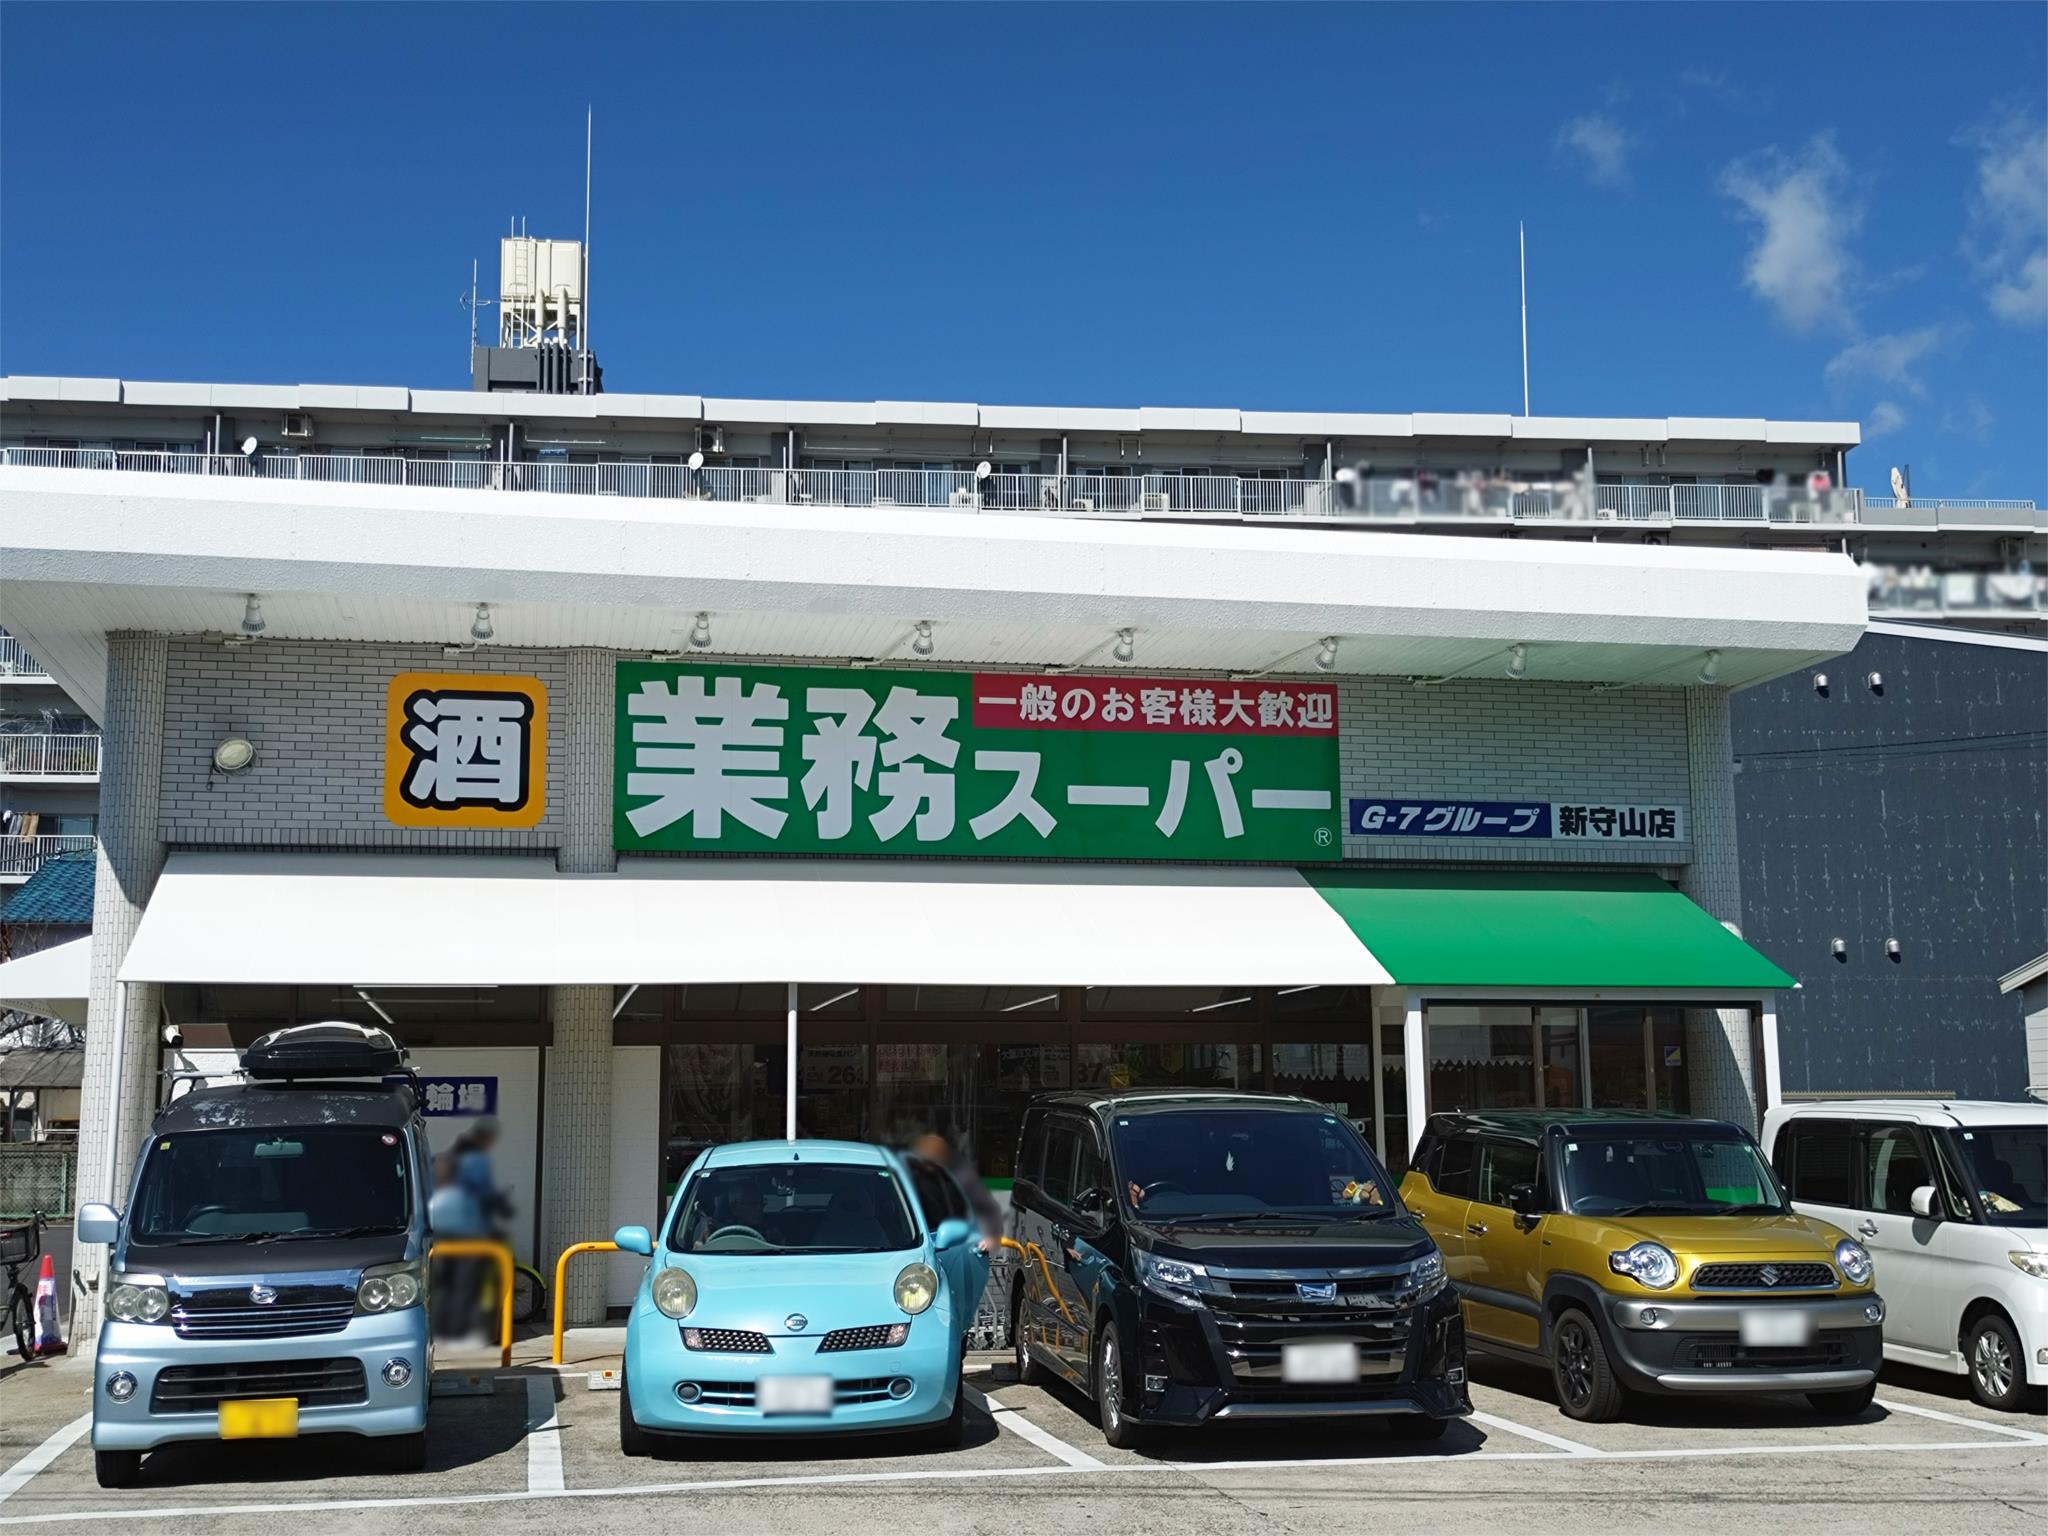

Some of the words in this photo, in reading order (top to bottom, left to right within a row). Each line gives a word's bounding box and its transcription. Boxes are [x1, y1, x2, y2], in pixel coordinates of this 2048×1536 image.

[978, 682, 1334, 729] 一般のお客様大歓迎
[408, 695, 527, 804] 酒
[624, 675, 1332, 842] 業務スーパー
[1360, 804, 1541, 835] G-7グループ
[1558, 805, 1676, 839] 新守山店
[422, 1082, 486, 1111] 輪場
